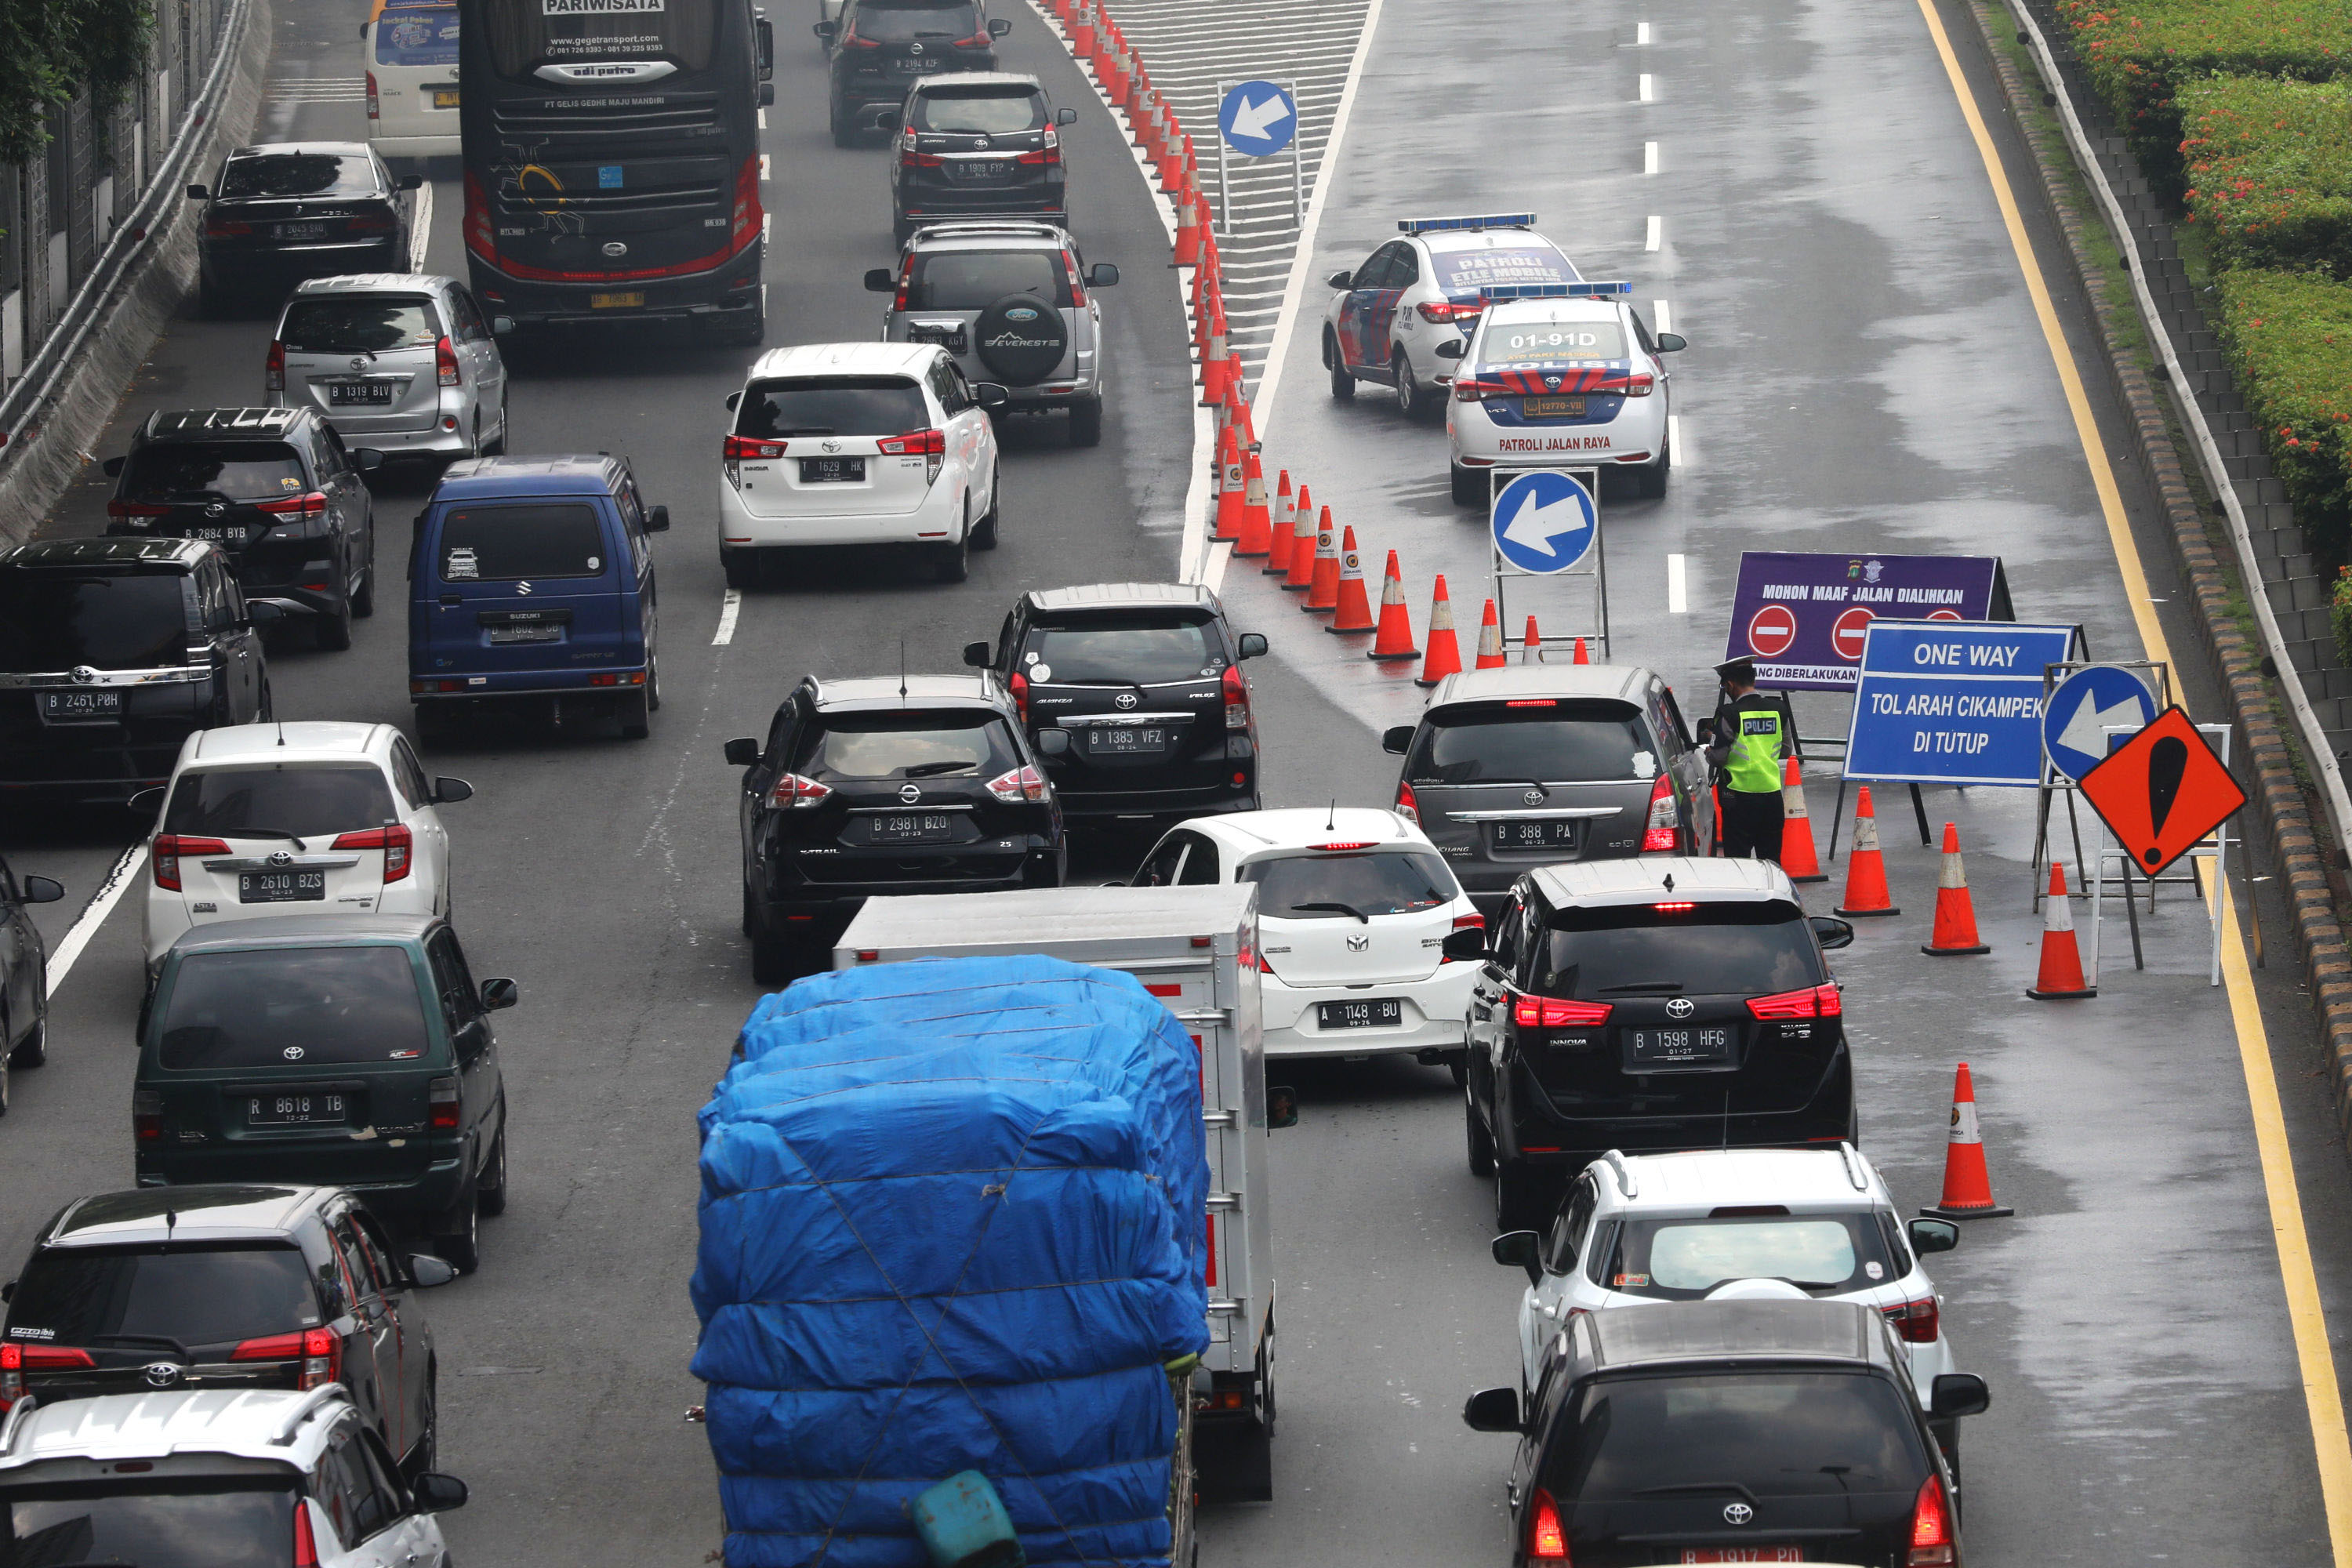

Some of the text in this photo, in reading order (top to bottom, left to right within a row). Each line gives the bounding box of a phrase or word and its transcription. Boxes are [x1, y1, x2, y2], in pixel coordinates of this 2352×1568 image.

[546, 0, 660, 12] PARIWISATA
[551, 35, 659, 45] www.gegetransport.com
[573, 67, 635, 76] adi putro
[959, 164, 964, 172] B
[990, 163, 1004, 172] FYP
[1459, 257, 1543, 270] PATROLI
[1451, 267, 1561, 282] ETLE MOBILE
[1012, 310, 1031, 319] Ford
[949, 336, 964, 346] KGY
[1510, 333, 1596, 348] 01-91D
[1486, 361, 1620, 372] POLISI
[332, 386, 389, 397] B 1319 BIV
[1499, 436, 1611, 451] PATROLI JALAN RAYA
[802, 460, 862, 472] T 1629 HK
[198, 528, 222, 539] 2884
[227, 528, 245, 539] BYB
[1762, 585, 1964, 604] MOHON MAAF JALAN DIALIHKAN
[1914, 644, 2020, 666] ONE WAY
[1774, 668, 1857, 681] DIBERLAKUKAN
[50, 695, 57, 708] B
[67, 695, 93, 707] 2461
[1872, 694, 2045, 718] TOL ARAH CIKAMPEK
[1744, 720, 1776, 733] POLISI
[1091, 730, 1162, 744] B 1385 VFZ
[1914, 731, 1989, 754] DI TUTUP
[874, 815, 947, 831] B 2981 BZQ
[1498, 824, 1571, 839] B 388 PA
[242, 873, 321, 890] B 2610 BZS
[1322, 1002, 1397, 1021] A 1148 BU
[1635, 1030, 1724, 1049] B 1598 HFG
[251, 1095, 343, 1114] R 8618 TB
[1686, 1548, 1759, 1565] B 1917
